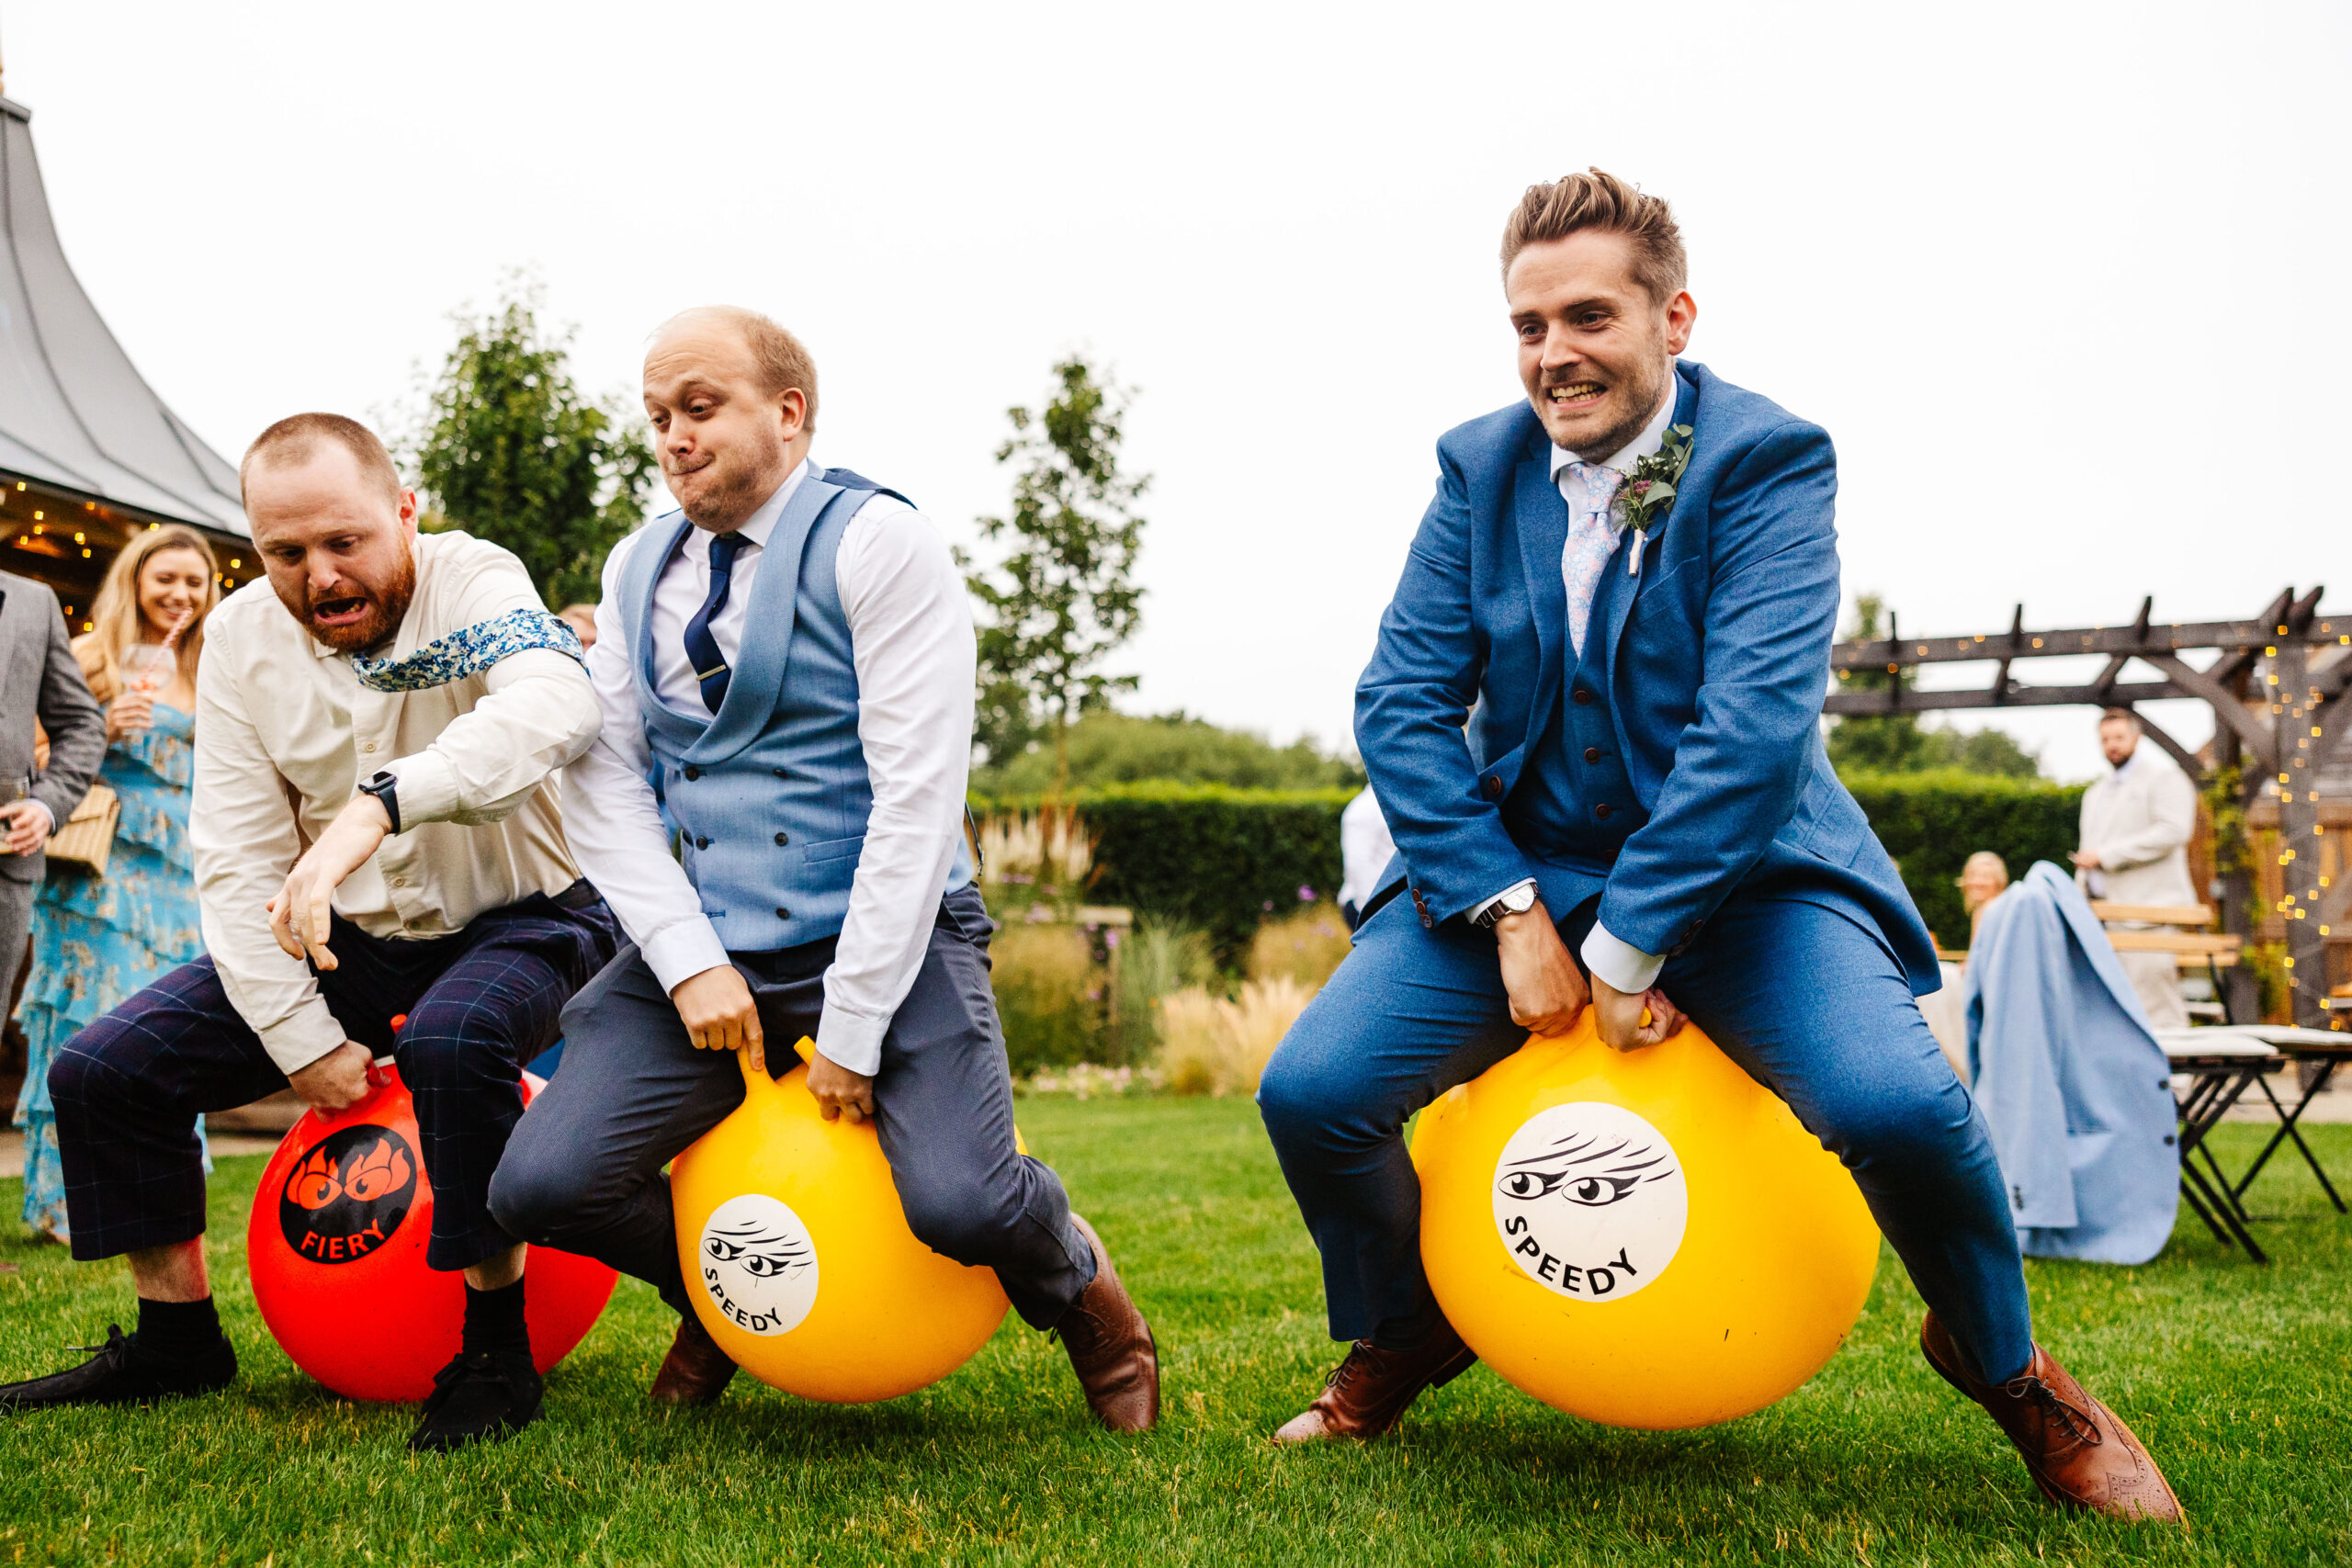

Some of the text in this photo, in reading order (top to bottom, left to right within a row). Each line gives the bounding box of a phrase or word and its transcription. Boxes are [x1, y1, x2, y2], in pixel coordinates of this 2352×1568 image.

[300, 1218, 386, 1259] FIERY
[1505, 1215, 1638, 1295] SPEEDY
[705, 1267, 783, 1331] SPEEDY
